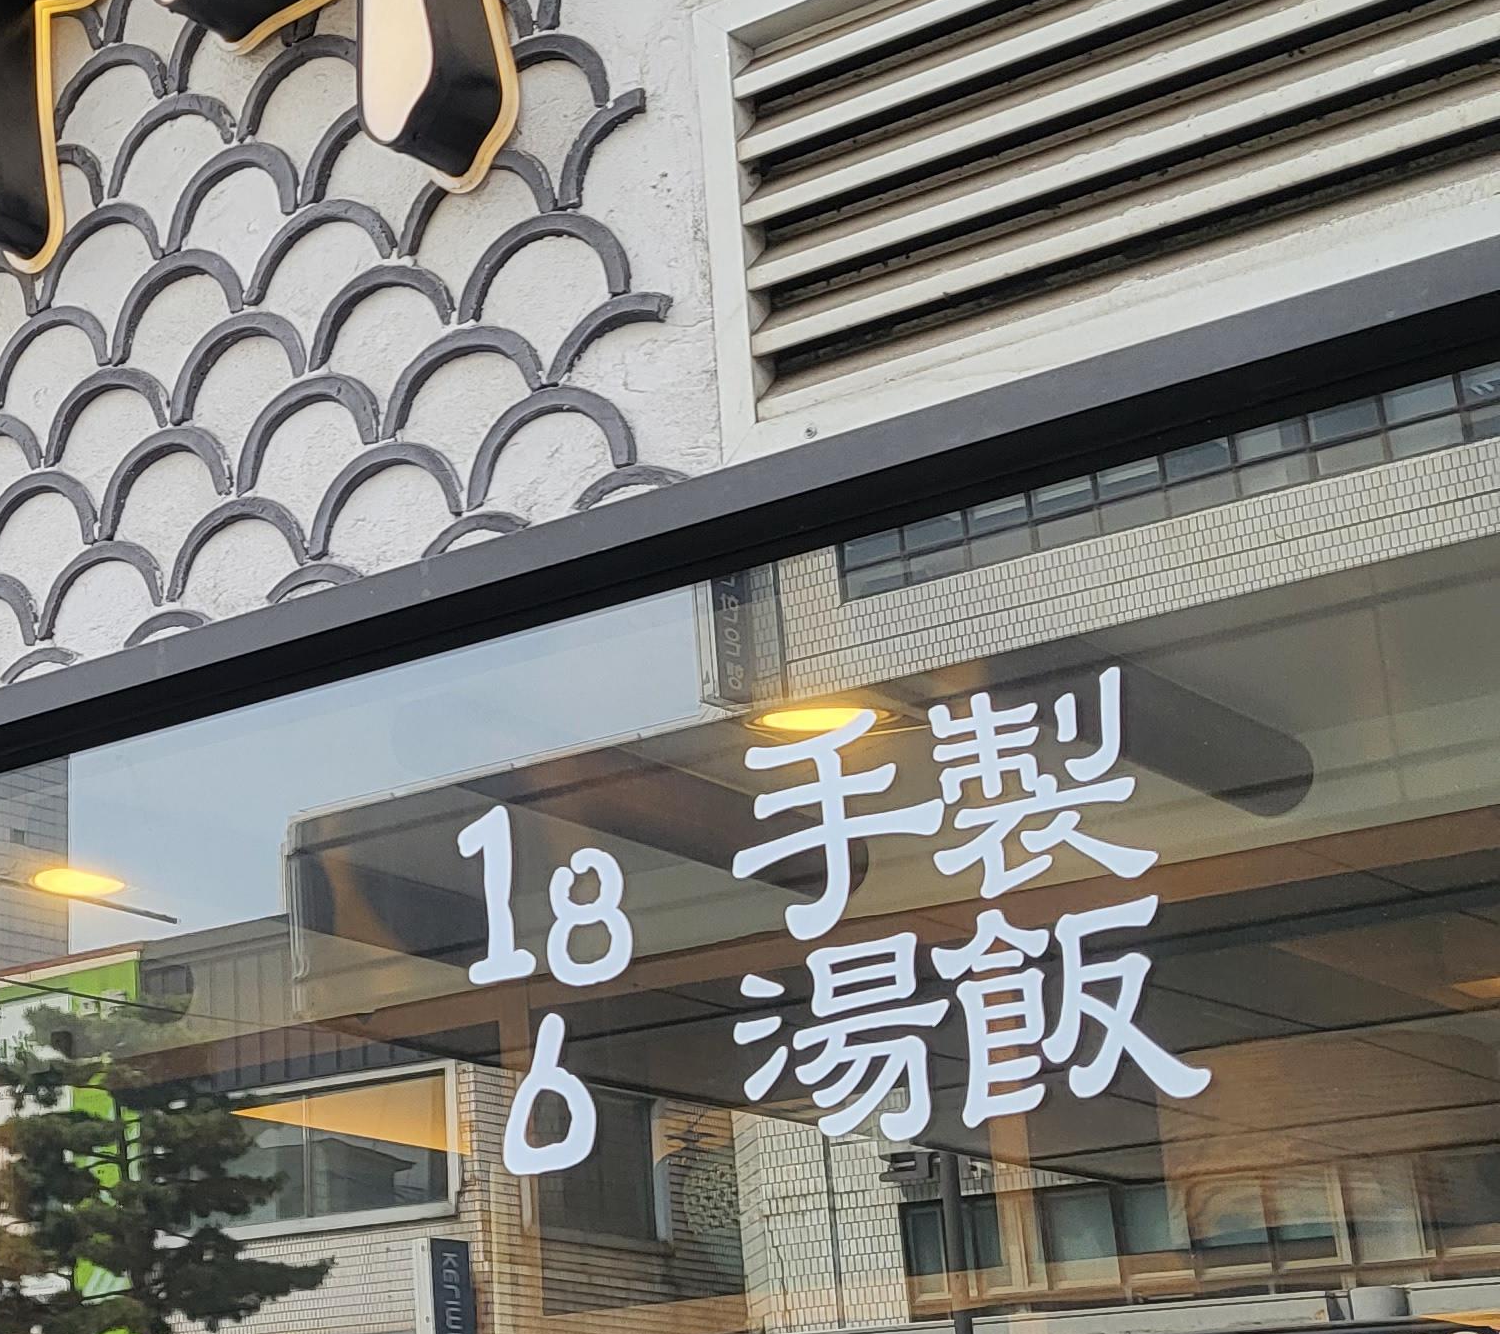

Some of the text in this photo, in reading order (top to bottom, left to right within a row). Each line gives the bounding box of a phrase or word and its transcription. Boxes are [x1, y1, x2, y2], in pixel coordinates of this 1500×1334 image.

[731, 666, 1160, 941] 手製
[502, 1013, 598, 1177] 6
[732, 893, 1212, 1143] 湯飯
